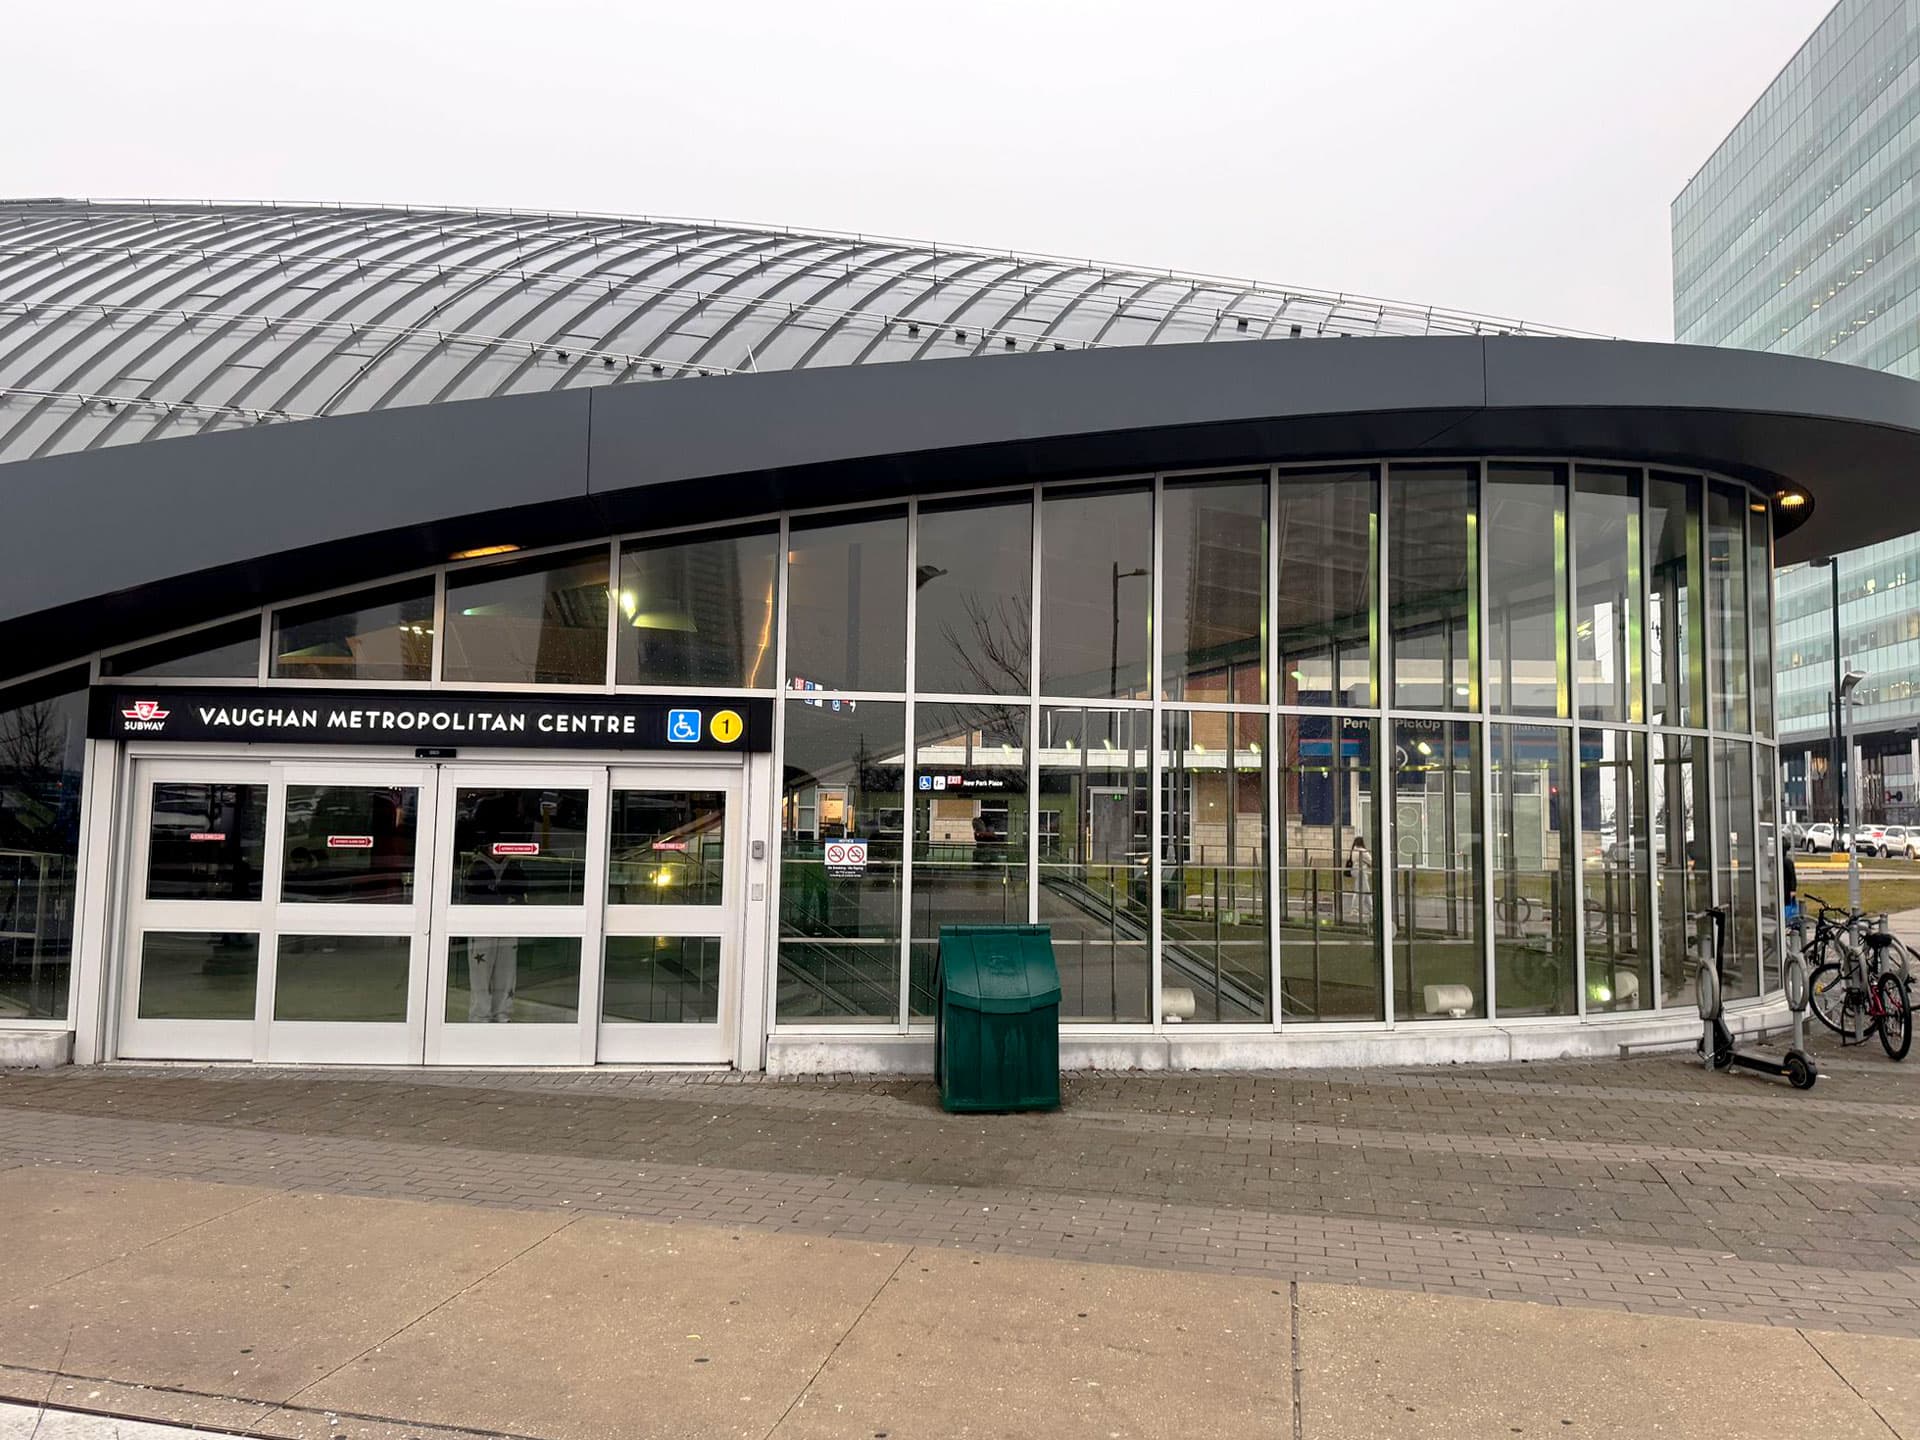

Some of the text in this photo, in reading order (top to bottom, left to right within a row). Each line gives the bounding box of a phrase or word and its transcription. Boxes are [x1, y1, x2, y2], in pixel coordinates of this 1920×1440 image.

[123, 720, 166, 732] SUBWAY
[199, 706, 636, 734] VAUGHAN METROPOLITAN CENTRE
[1343, 718, 1370, 729] Pen
[721, 718, 732, 735] 1
[948, 776, 961, 784] EXIT
